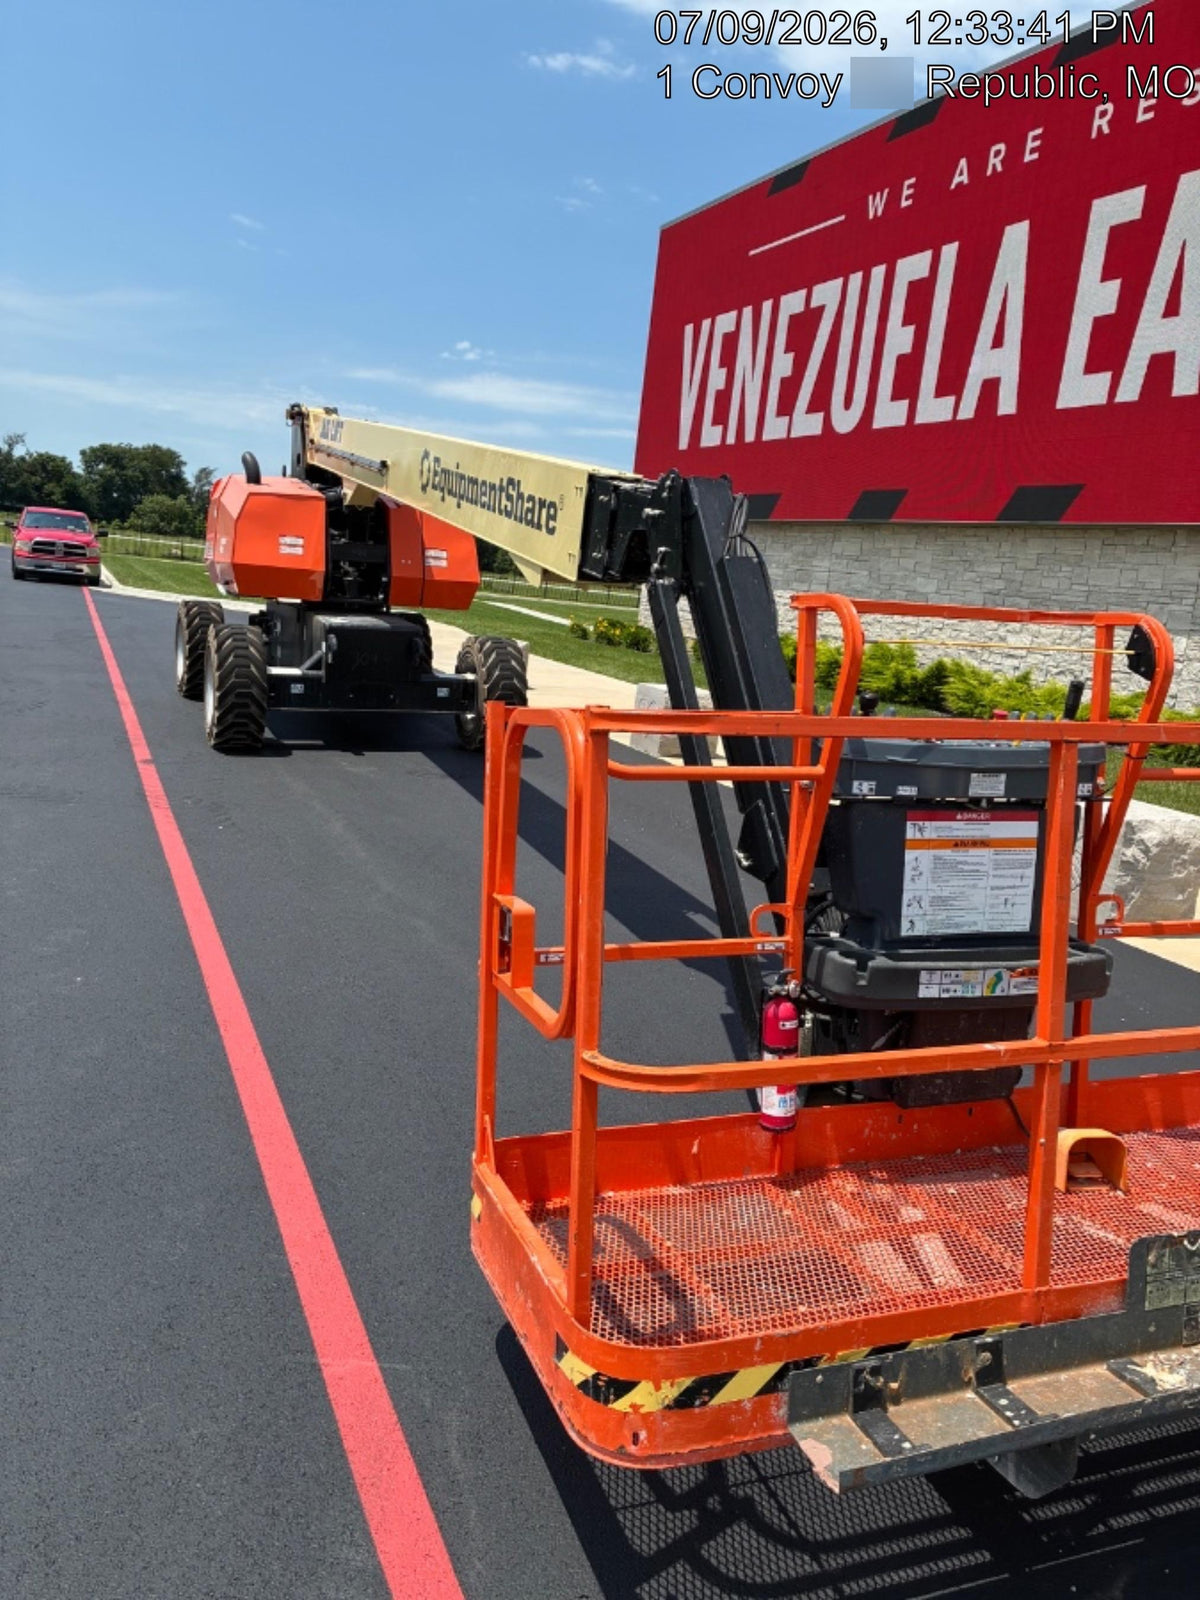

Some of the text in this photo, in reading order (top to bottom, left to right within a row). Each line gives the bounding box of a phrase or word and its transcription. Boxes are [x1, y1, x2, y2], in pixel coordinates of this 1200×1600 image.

[868, 177, 917, 221] WE
[950, 126, 1045, 191] ARE
[678, 167, 1200, 451] VENEZUELA EA
[431, 456, 559, 536] EquipmentShare
